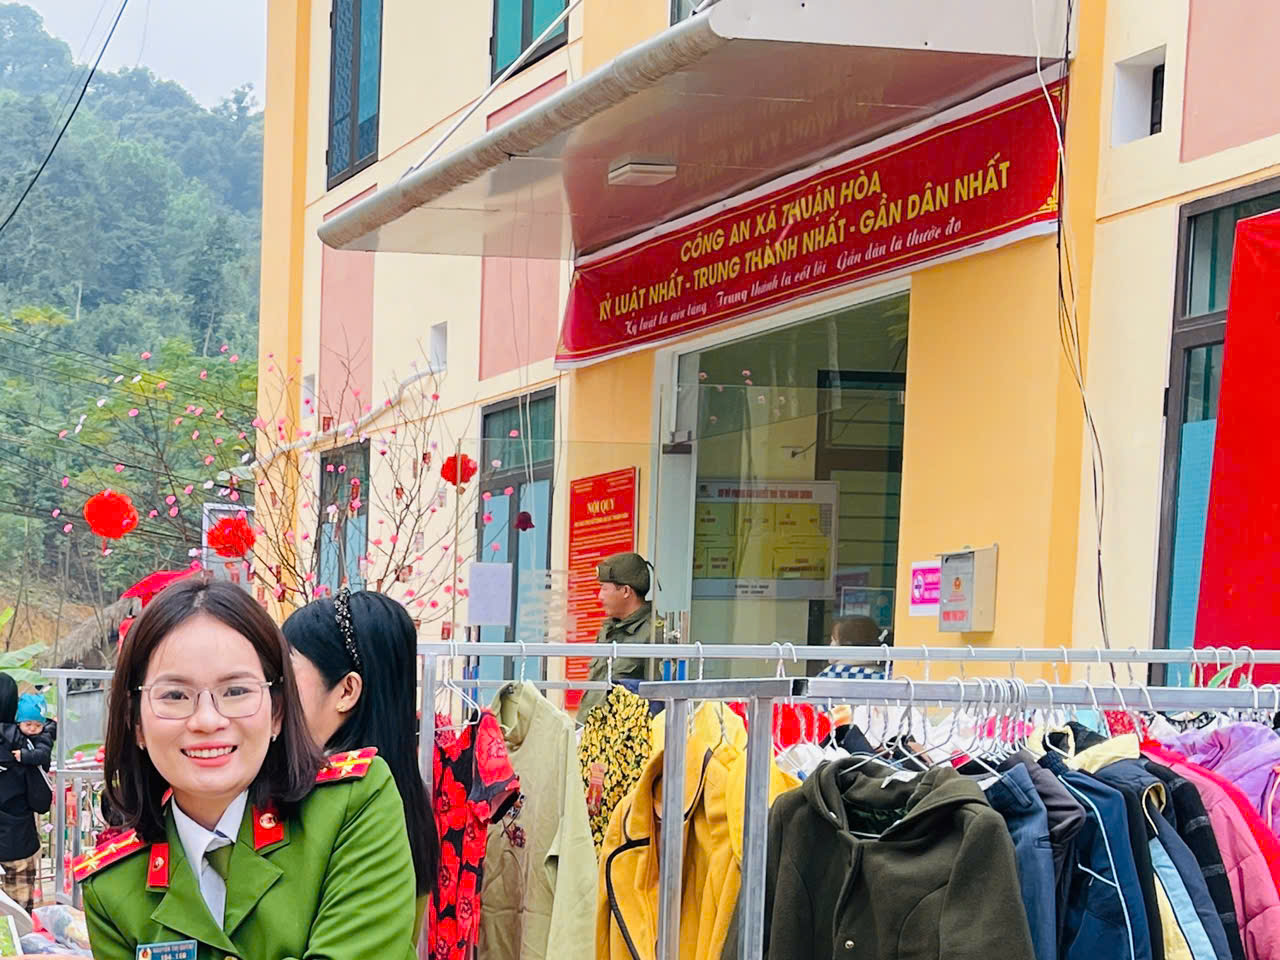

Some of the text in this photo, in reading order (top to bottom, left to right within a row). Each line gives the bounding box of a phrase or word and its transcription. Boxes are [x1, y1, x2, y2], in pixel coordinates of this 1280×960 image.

[599, 292, 612, 322] KỶ
[615, 285, 646, 317] LUẬT
[648, 268, 684, 309] NHẤT
[693, 256, 741, 291] TRUNG
[744, 237, 798, 274] THÀNH
[802, 210, 847, 255] NHẤT
[859, 192, 903, 234] GẦN
[907, 181, 950, 220] DÂN
[954, 152, 1011, 204] NHẤT
[680, 169, 882, 263] CÔNG AN XÃ THUẬN HÒA
[716, 289, 747, 306] Trung
[890, 235, 903, 252] là
[906, 225, 942, 248] thước
[945, 216, 962, 236] đo
